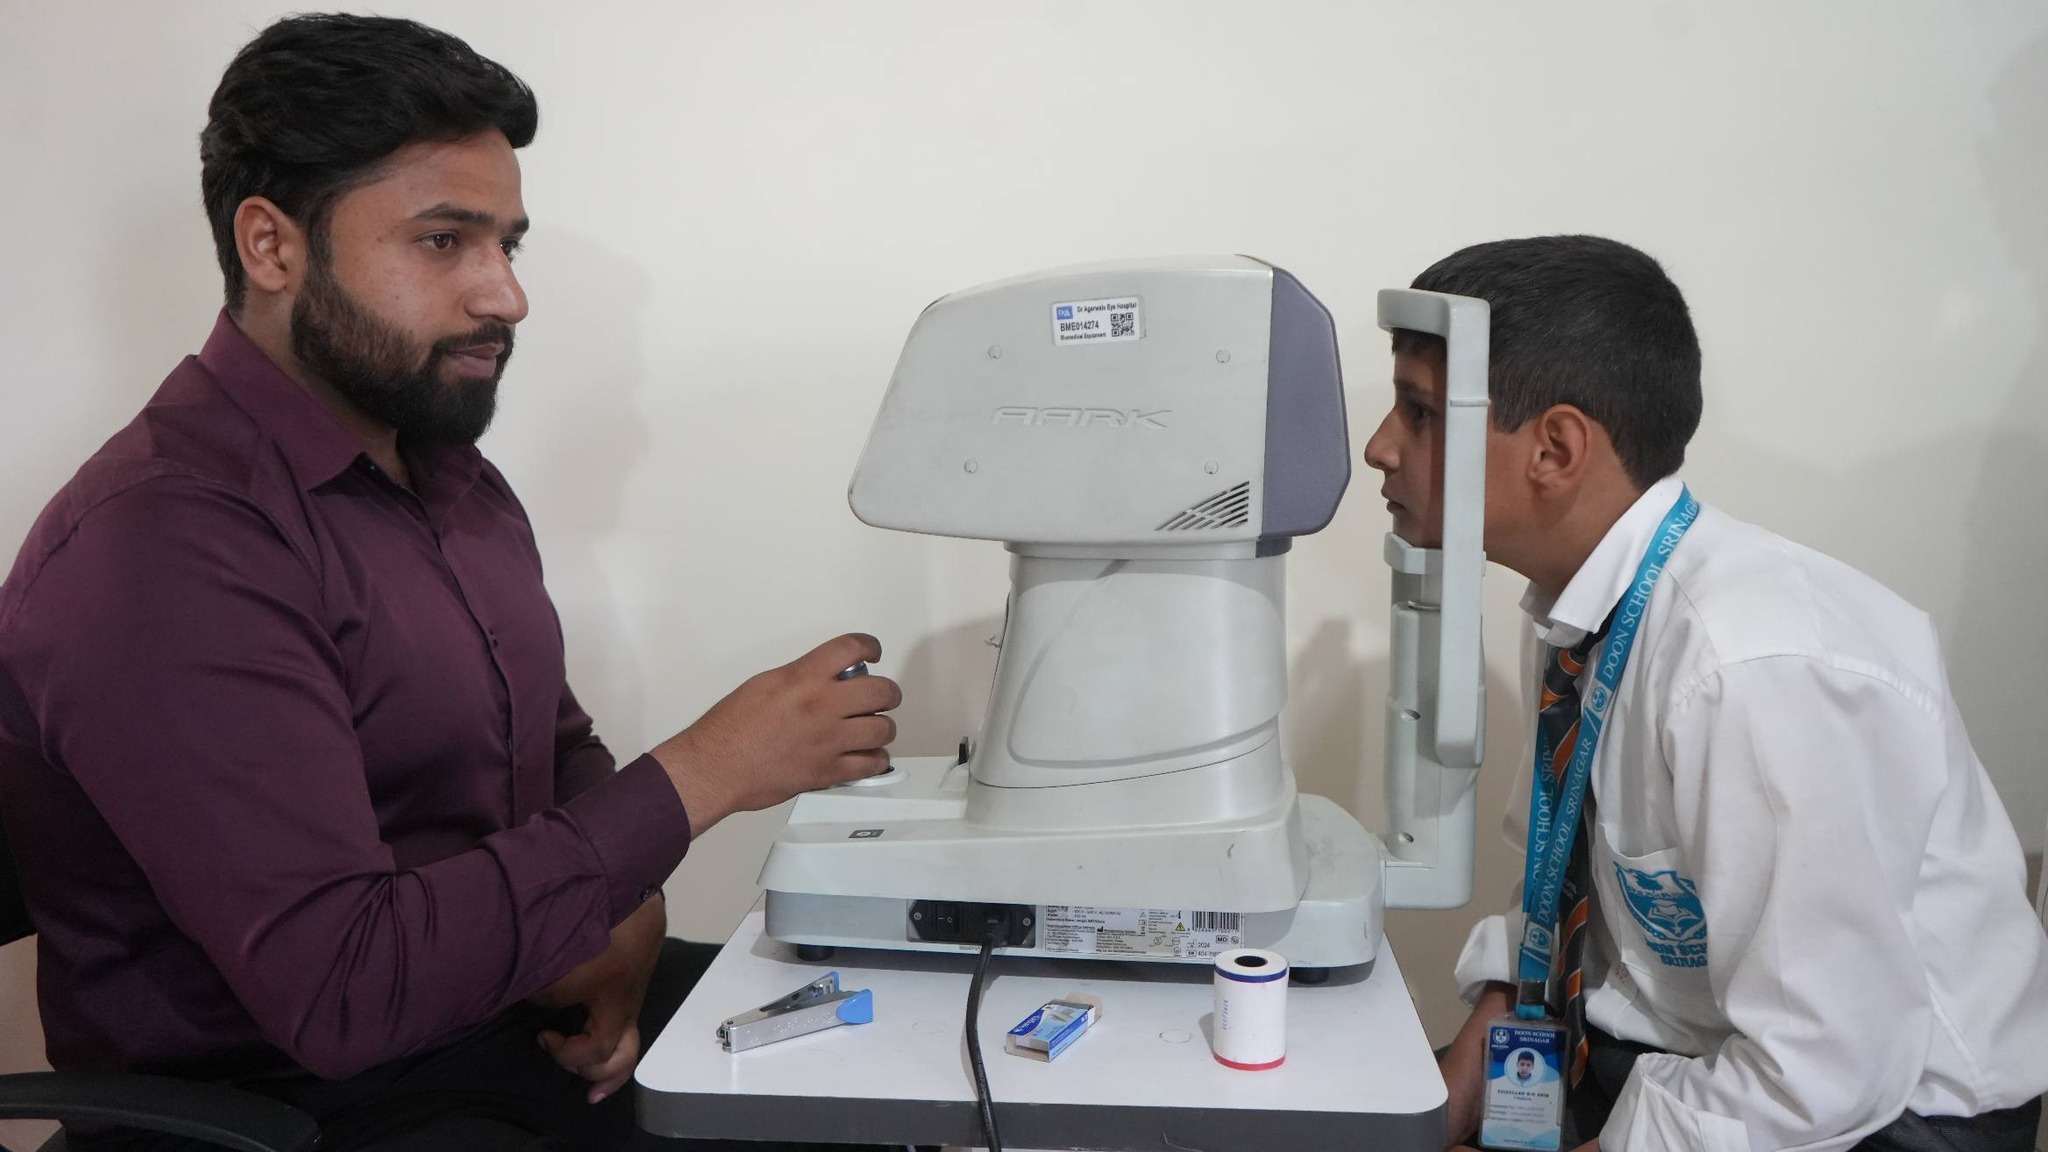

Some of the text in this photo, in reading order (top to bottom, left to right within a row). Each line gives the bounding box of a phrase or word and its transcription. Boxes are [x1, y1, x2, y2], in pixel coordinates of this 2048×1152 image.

[1107, 302, 1116, 312] Eye
[1117, 301, 1137, 310] Hospital
[1060, 320, 1100, 332] BME014274
[991, 406, 1172, 427] AARK
[1603, 499, 1699, 681] DOON SCHOOL SRINAG
[1535, 788, 1554, 853] SCHOOL
[1537, 879, 1556, 924] DOON
[1547, 822, 1572, 881] SCHOOL
[1566, 738, 1592, 819] SRINAGAR
[1514, 1029, 1556, 1038] DOON SCHOOL
[1519, 1036, 1550, 1044] SRINAGAR
